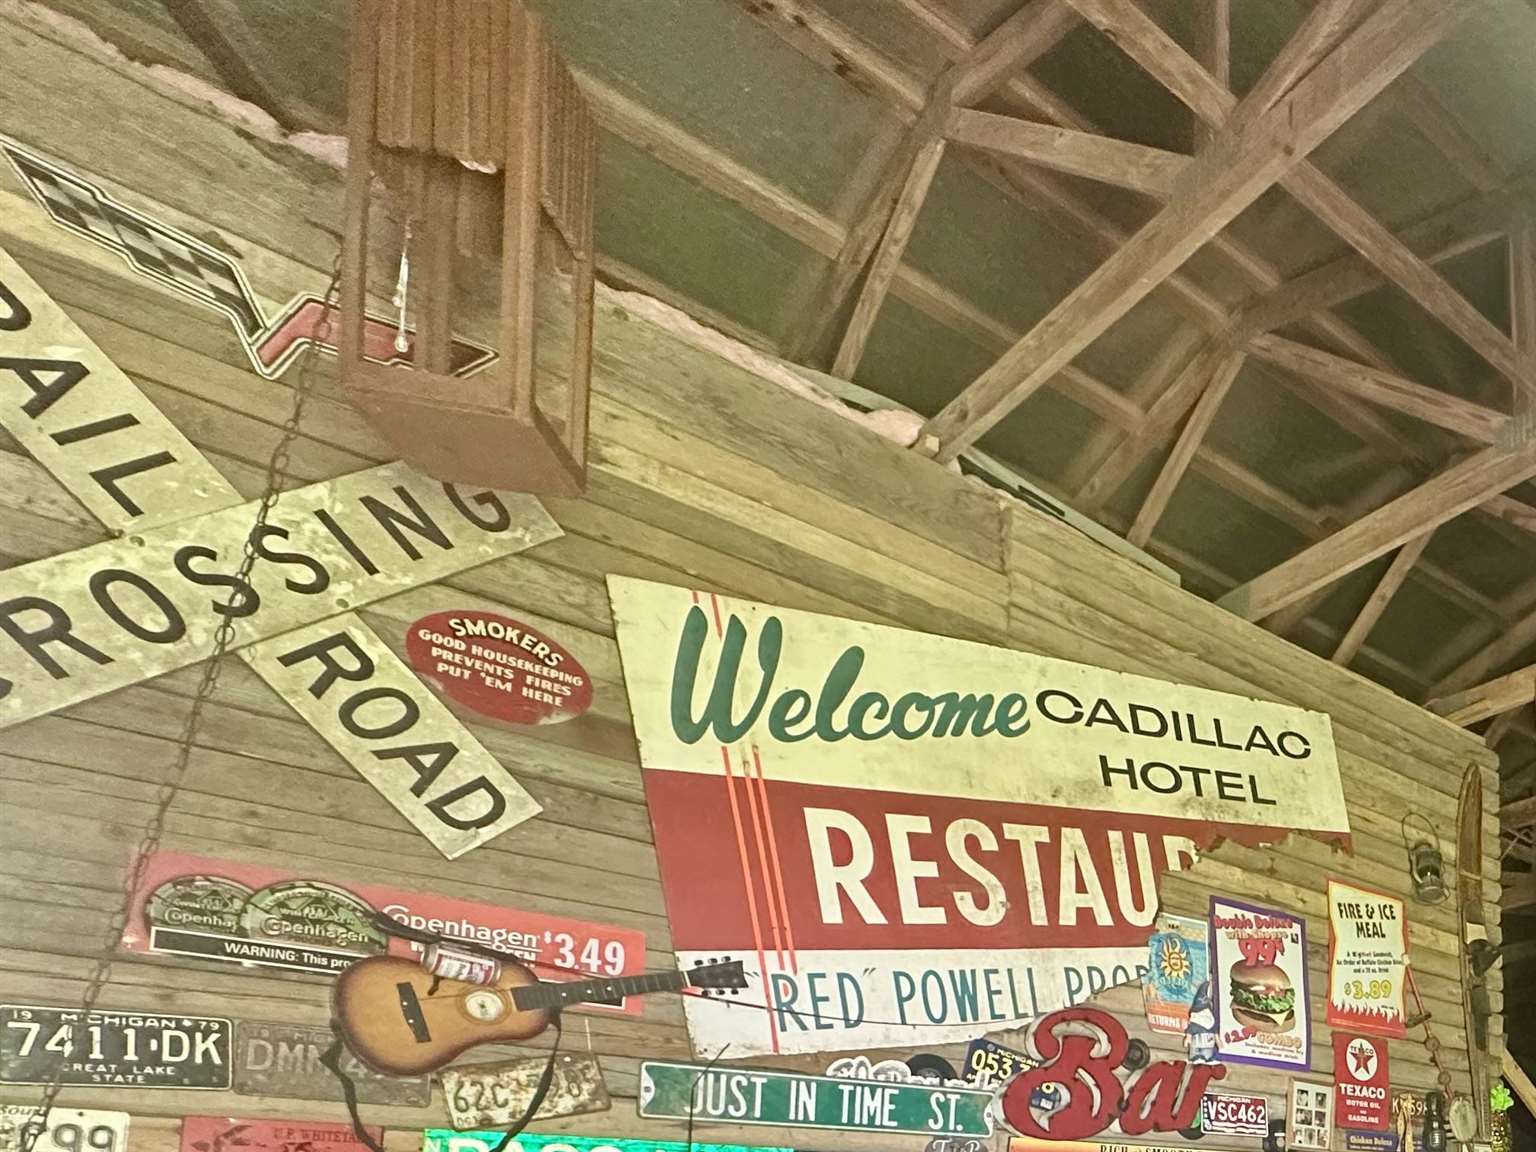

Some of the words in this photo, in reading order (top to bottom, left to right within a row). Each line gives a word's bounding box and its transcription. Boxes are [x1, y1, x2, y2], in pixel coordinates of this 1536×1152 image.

[0, 482, 512, 700] ROSSING
[418, 629, 466, 651] GOOD
[471, 645, 583, 687] HOUSEKEEPING
[449, 618, 564, 667] SMOKERS
[431, 647, 514, 680] PREVENTS
[526, 675, 571, 696] FIRES
[437, 663, 472, 680] PUT
[522, 687, 564, 708] HERE
[670, 605, 1032, 744] Welcome
[278, 631, 506, 830] ROAD
[1036, 688, 1312, 760] CADILLAC
[1100, 754, 1277, 806] HOTEL
[1337, 902, 1363, 919] FIRE
[1365, 904, 1375, 919] &
[1378, 904, 1396, 920] ICE
[1356, 921, 1386, 939] MEAL
[225, 942, 299, 962] WARNING:
[303, 953, 327, 965] This
[544, 931, 625, 976] $3.49
[893, 967, 1039, 1026] POWELL
[1344, 980, 1392, 999] $3.89
[13, 1010, 33, 1020] 19
[199, 1021, 220, 1030] 79
[62, 1063, 118, 1073] GREAT
[133, 1066, 176, 1075] LAKE
[93, 1074, 146, 1084] STATE
[1002, 1008, 1227, 1141] Bar
[1339, 1084, 1385, 1099] TEXACO
[683, 1074, 768, 1118] JUST
[788, 1080, 817, 1121] IN
[838, 1084, 899, 1127] TIME
[928, 1091, 964, 1132] ST.
[1208, 1101, 1266, 1124] VSC462
